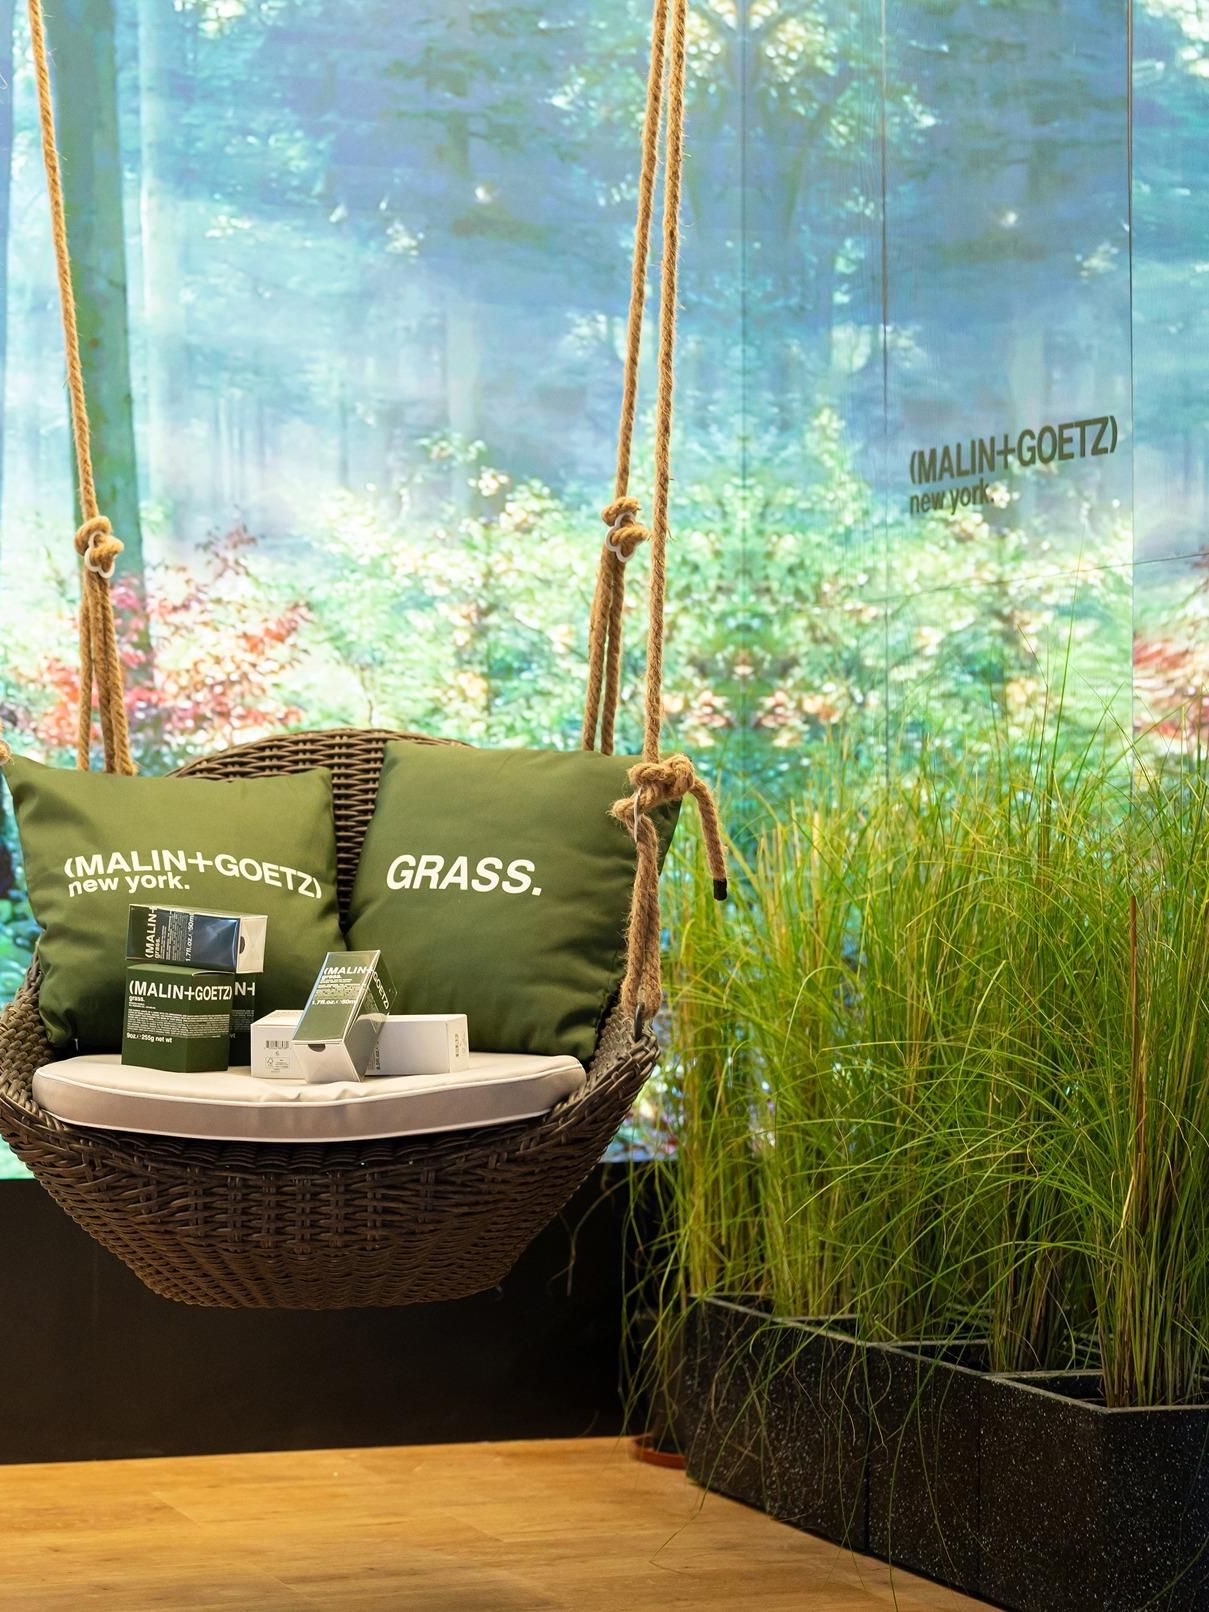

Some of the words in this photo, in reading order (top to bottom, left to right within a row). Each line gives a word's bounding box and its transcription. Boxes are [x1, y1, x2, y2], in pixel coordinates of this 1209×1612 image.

[909, 415, 1119, 485] (MALIN+GOETZ)
[909, 490, 946, 516] new
[950, 476, 995, 515] york.
[64, 849, 323, 899] (MALIN+GOETZ)
[68, 877, 119, 898] new
[124, 872, 190, 894] york.
[386, 854, 542, 896] GRASS.
[129, 980, 233, 1001] (MALIN+GOETZ)
